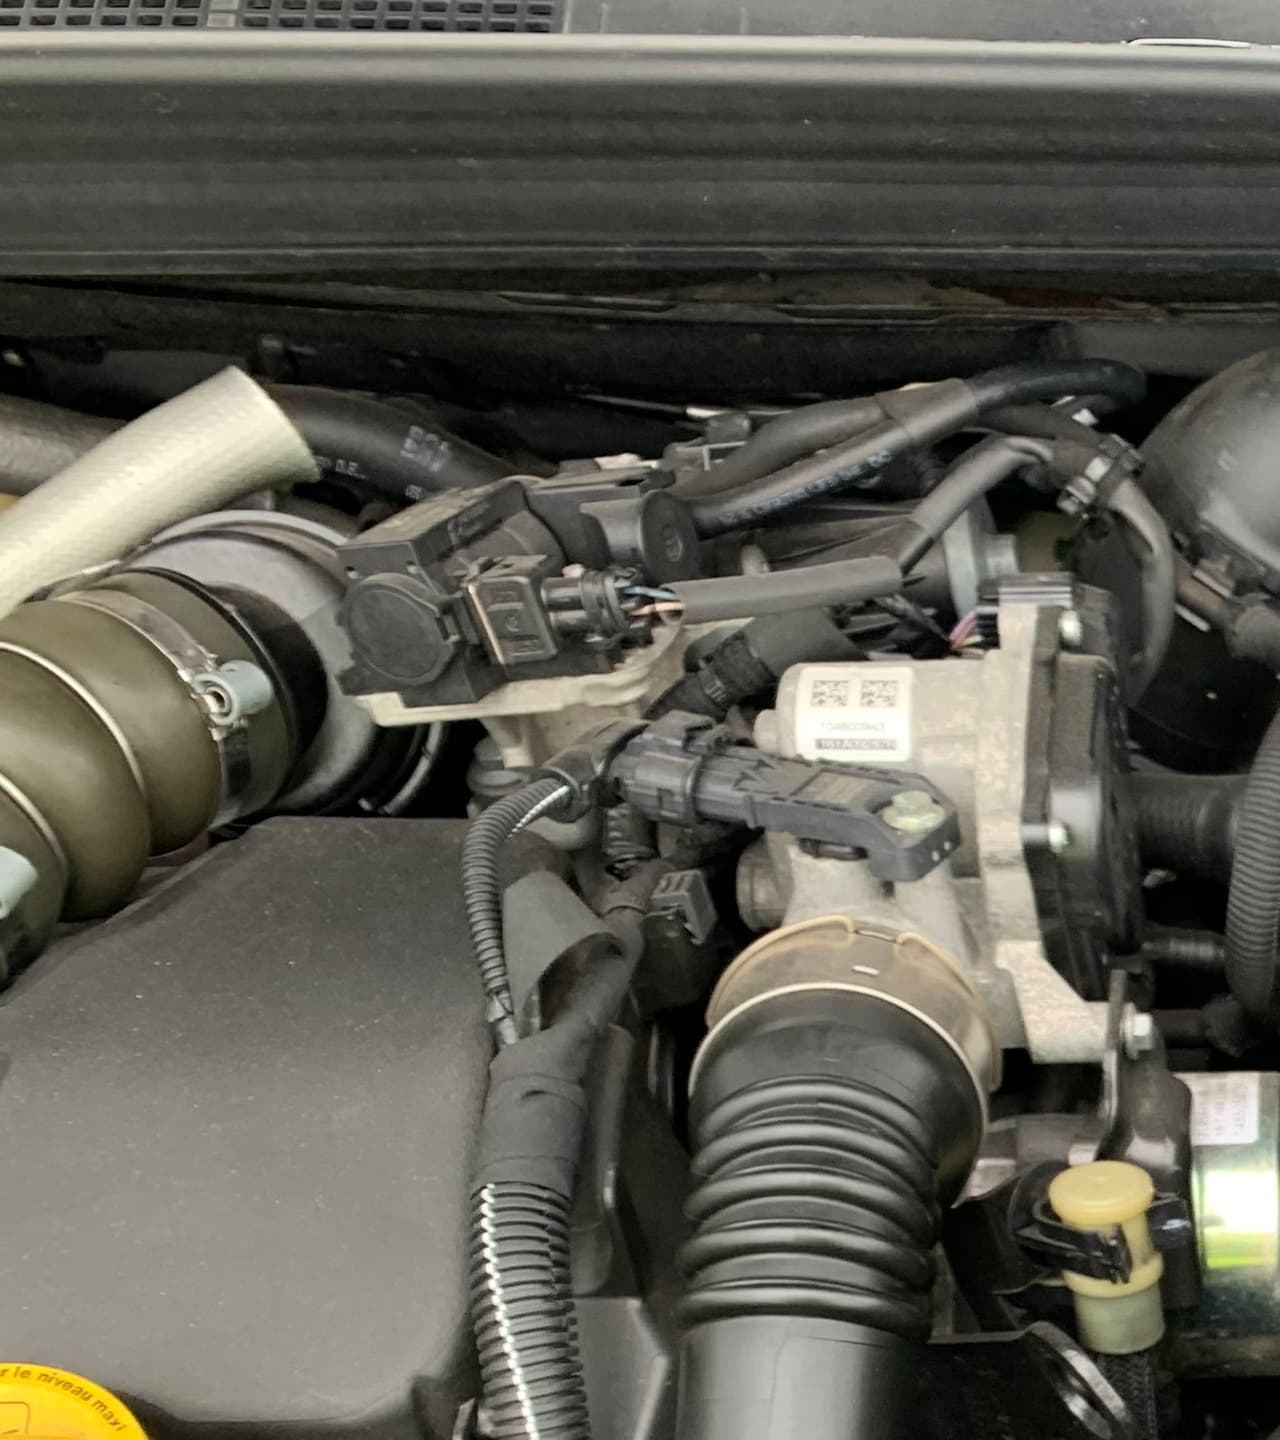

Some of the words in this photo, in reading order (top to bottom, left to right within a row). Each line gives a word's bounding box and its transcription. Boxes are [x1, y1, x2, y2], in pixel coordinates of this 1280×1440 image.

[13, 1365, 32, 1379] le
[37, 1372, 93, 1401] niveau
[91, 1399, 127, 1431] maxi
